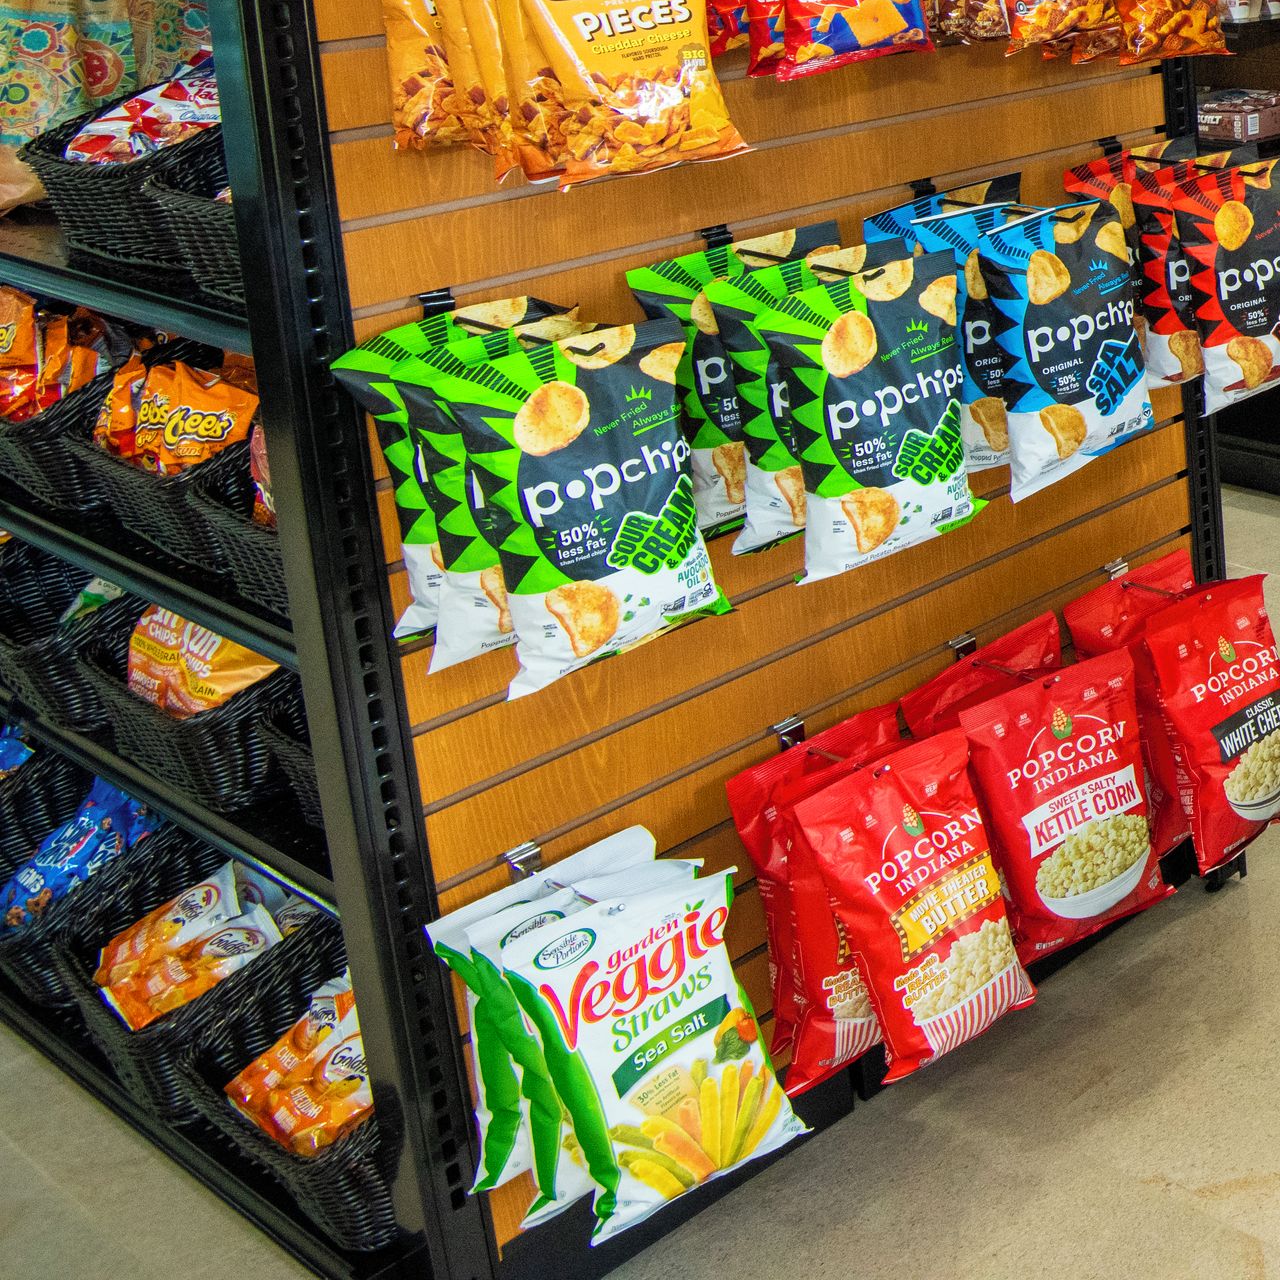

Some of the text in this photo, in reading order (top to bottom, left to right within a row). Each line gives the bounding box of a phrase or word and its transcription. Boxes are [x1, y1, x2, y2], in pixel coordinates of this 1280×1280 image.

[592, 29, 691, 54] Cheddar Cheese
[683, 50, 705, 59] BIG
[1230, 297, 1266, 311] ORIGINAL
[1248, 310, 1264, 320] 50%
[880, 334, 924, 363] Never Fried
[1027, 299, 1133, 363] popchip
[910, 342, 940, 358] Always
[1042, 357, 1084, 375] ORIGINAL
[1089, 343, 1126, 393] SEA
[1058, 374, 1077, 387] 50%
[1096, 340, 1145, 416] SALT
[594, 402, 648, 437] Never Fried
[632, 410, 668, 429] Always
[827, 363, 963, 441] popchips
[852, 450, 893, 469] less fat
[854, 436, 886, 457] 50%
[894, 431, 928, 478] SOUR
[523, 436, 690, 528] popchips
[558, 537, 607, 560] less fat
[560, 521, 598, 546] 50%
[610, 515, 651, 567] SOUR
[148, 622, 176, 645] CHIPS
[1219, 667, 1280, 706] INDIANA
[1246, 697, 1274, 719] CLASSIC
[1007, 721, 1126, 790] POPCORN
[1220, 721, 1259, 758] WHITE
[1033, 749, 1118, 794] INDIANA
[1048, 776, 1116, 813] SWEET SALTY
[1033, 780, 1137, 848] KETTLE CORN
[865, 808, 983, 895] POPCORN
[895, 840, 975, 897] INDIANA
[909, 865, 987, 922] MOVIE THEATER
[921, 879, 991, 935] BUTTER
[542, 934, 577, 960] Sensible
[606, 919, 679, 974] garden
[539, 906, 728, 1052] Veggie
[895, 968, 919, 990] Made
[904, 971, 948, 1008] BUTTER
[907, 969, 936, 993] REAL
[612, 965, 713, 1053] Straws
[634, 1012, 709, 1071] Sea Salt
